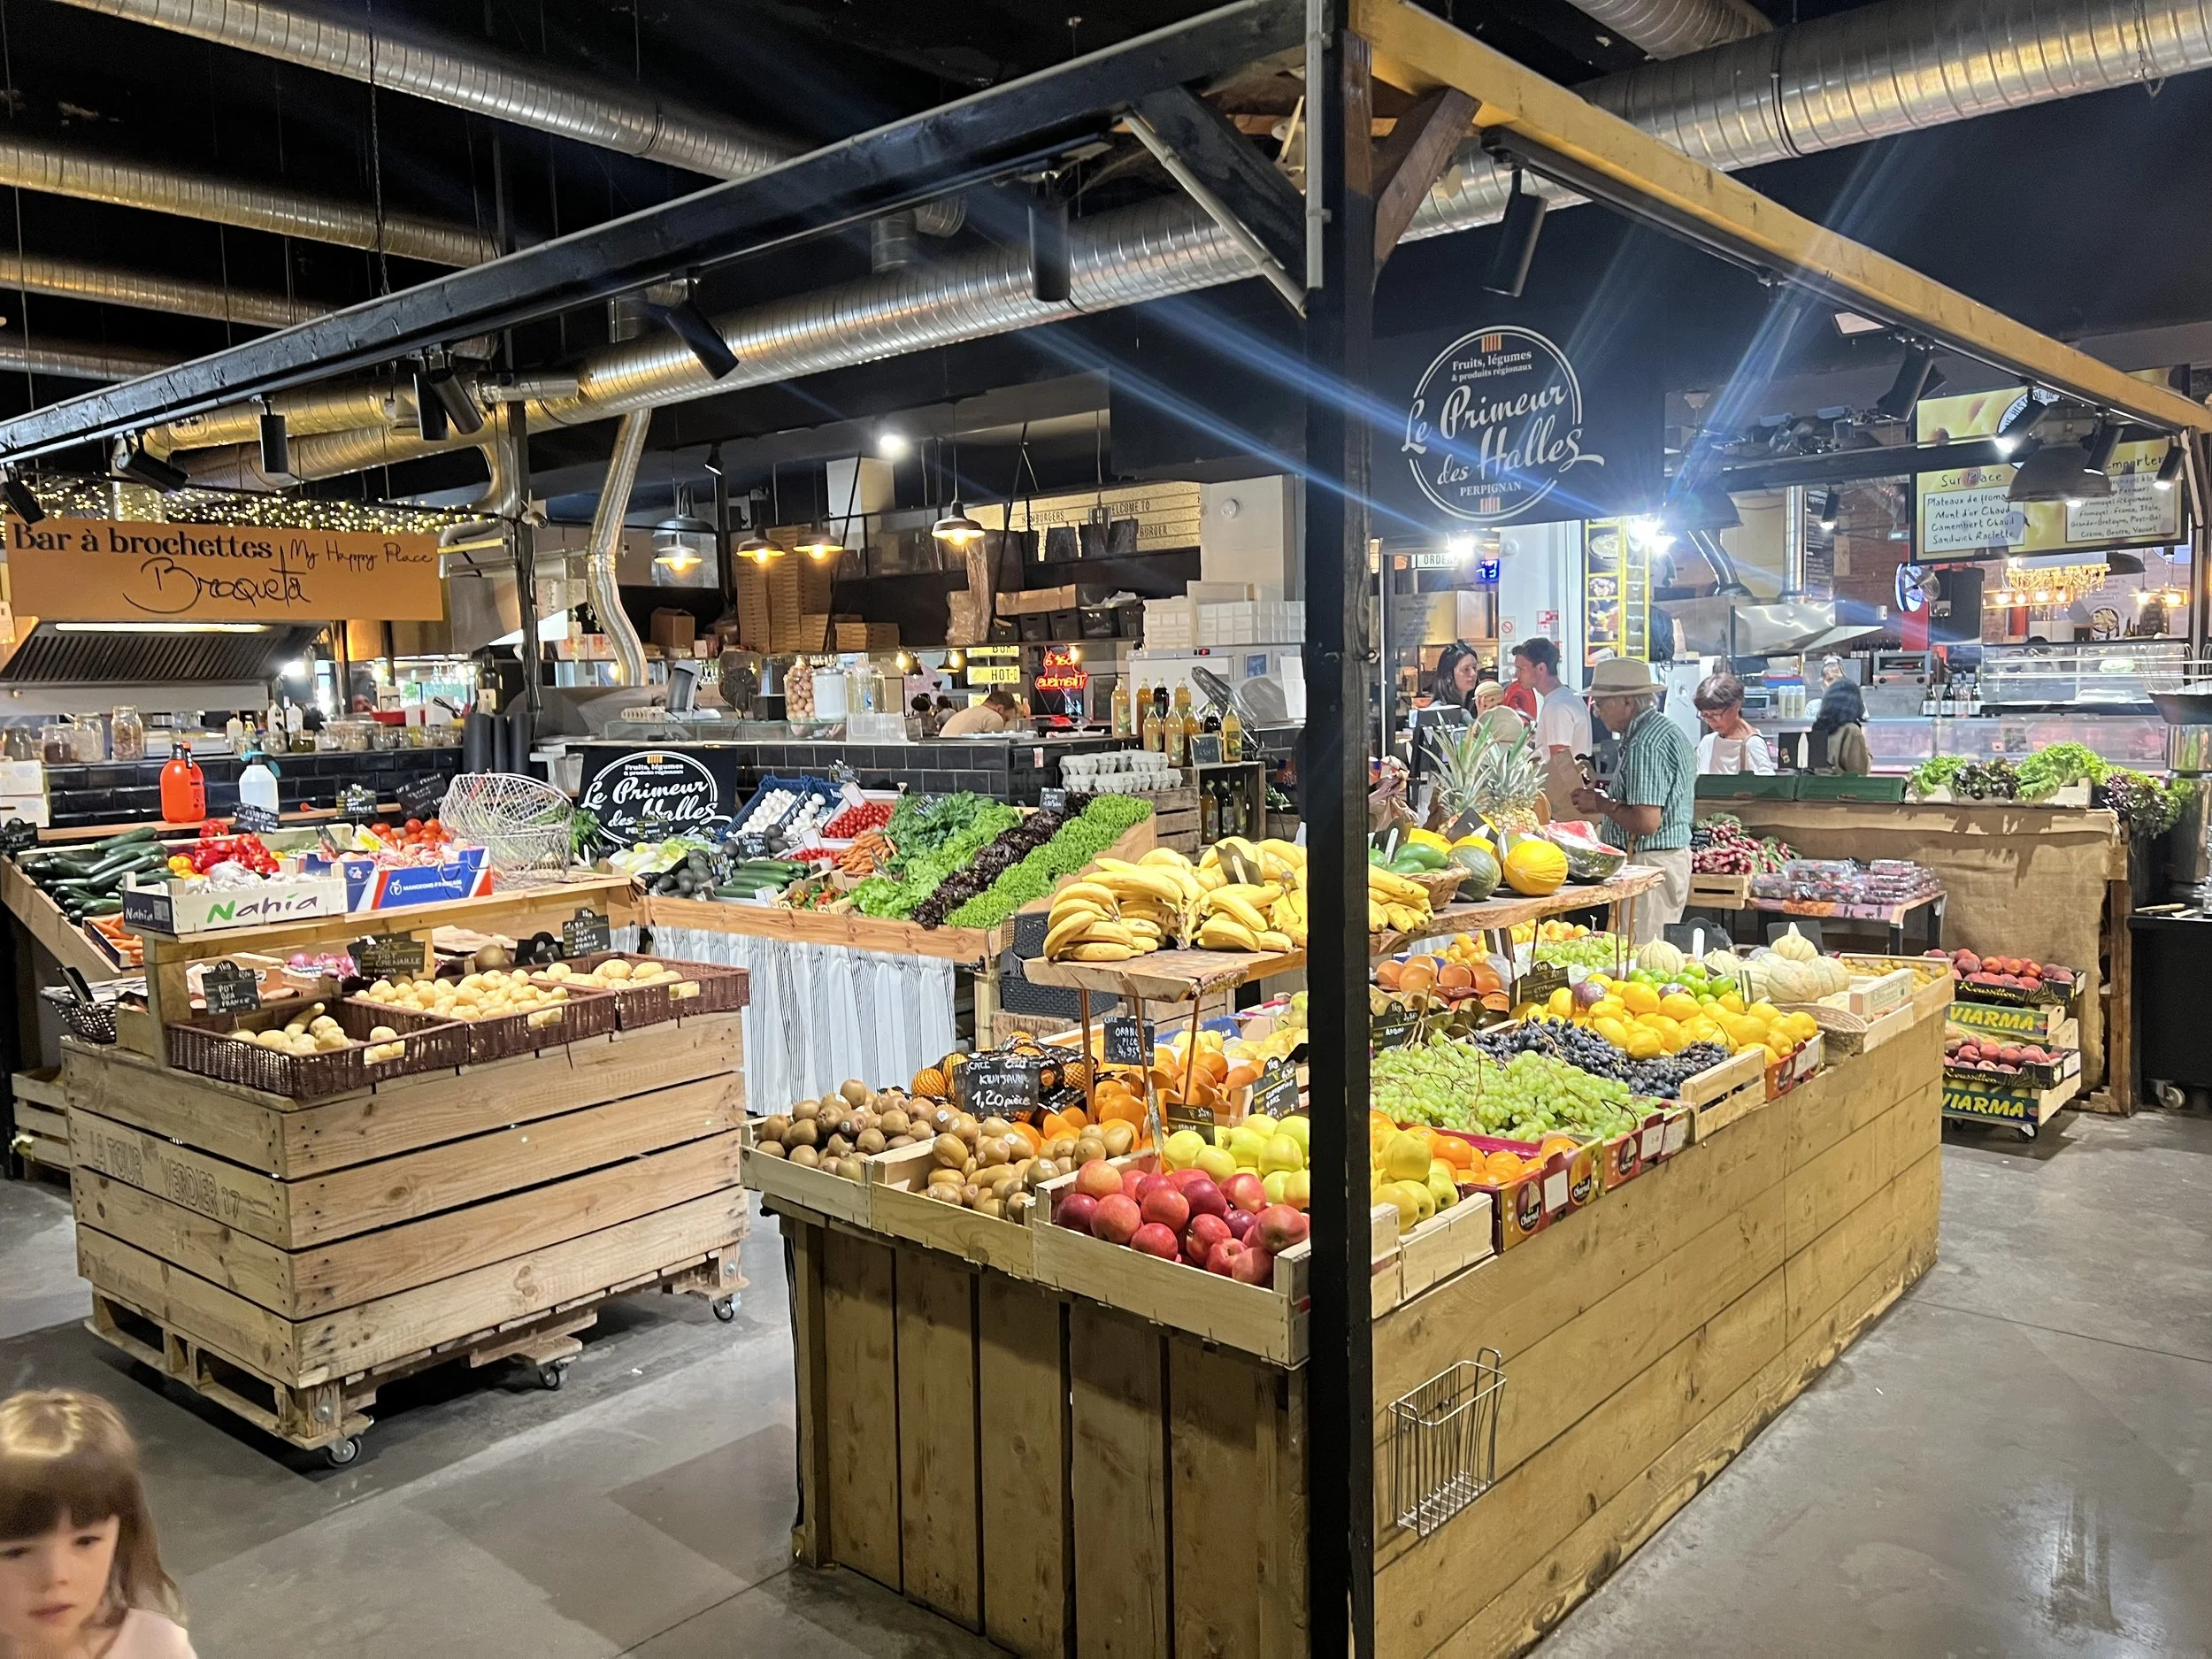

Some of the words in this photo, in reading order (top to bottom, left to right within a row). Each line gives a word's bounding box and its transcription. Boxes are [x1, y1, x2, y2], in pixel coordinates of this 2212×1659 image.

[1452, 357, 1486, 372] Fruits,
[1487, 350, 1532, 368] légumes
[1451, 373, 1458, 382] &
[1459, 368, 1492, 383] produits
[1493, 364, 1532, 376] régionaux
[1401, 398, 1432, 455] Le
[1440, 385, 1569, 440] Primeur
[1437, 454, 1473, 485] des
[1477, 414, 1605, 480] Halles
[2108, 454, 2164, 470] mporter
[1460, 481, 1522, 496] PERPIGNAN
[1940, 475, 1962, 488] Sur
[1141, 501, 1150, 511] TO
[1927, 497, 1964, 507] Plateaux
[1966, 495, 1978, 503] de
[1021, 511, 1064, 524] HMBURGERS
[1935, 509, 1959, 519] Mont
[1931, 519, 1984, 532] Camembert
[1986, 516, 2015, 527] Chaud
[13, 523, 71, 551] Bar
[81, 528, 99, 552] à
[109, 526, 273, 558] brochettes
[1932, 534, 1973, 545] Sandwich
[1975, 529, 2014, 541] Raclette
[289, 538, 319, 569] My
[326, 539, 379, 572] Happy
[382, 541, 434, 565] Place
[122, 544, 312, 614] Broqueta
[580, 780, 608, 810] Le
[612, 777, 709, 804] Primeur
[608, 809, 636, 827] des
[403, 882, 434, 892] MANGEONS
[1536, 963, 1548, 972] 1kg
[1391, 1002, 1402, 1012] 1kg
[972, 1089, 1003, 1109] 1,20
